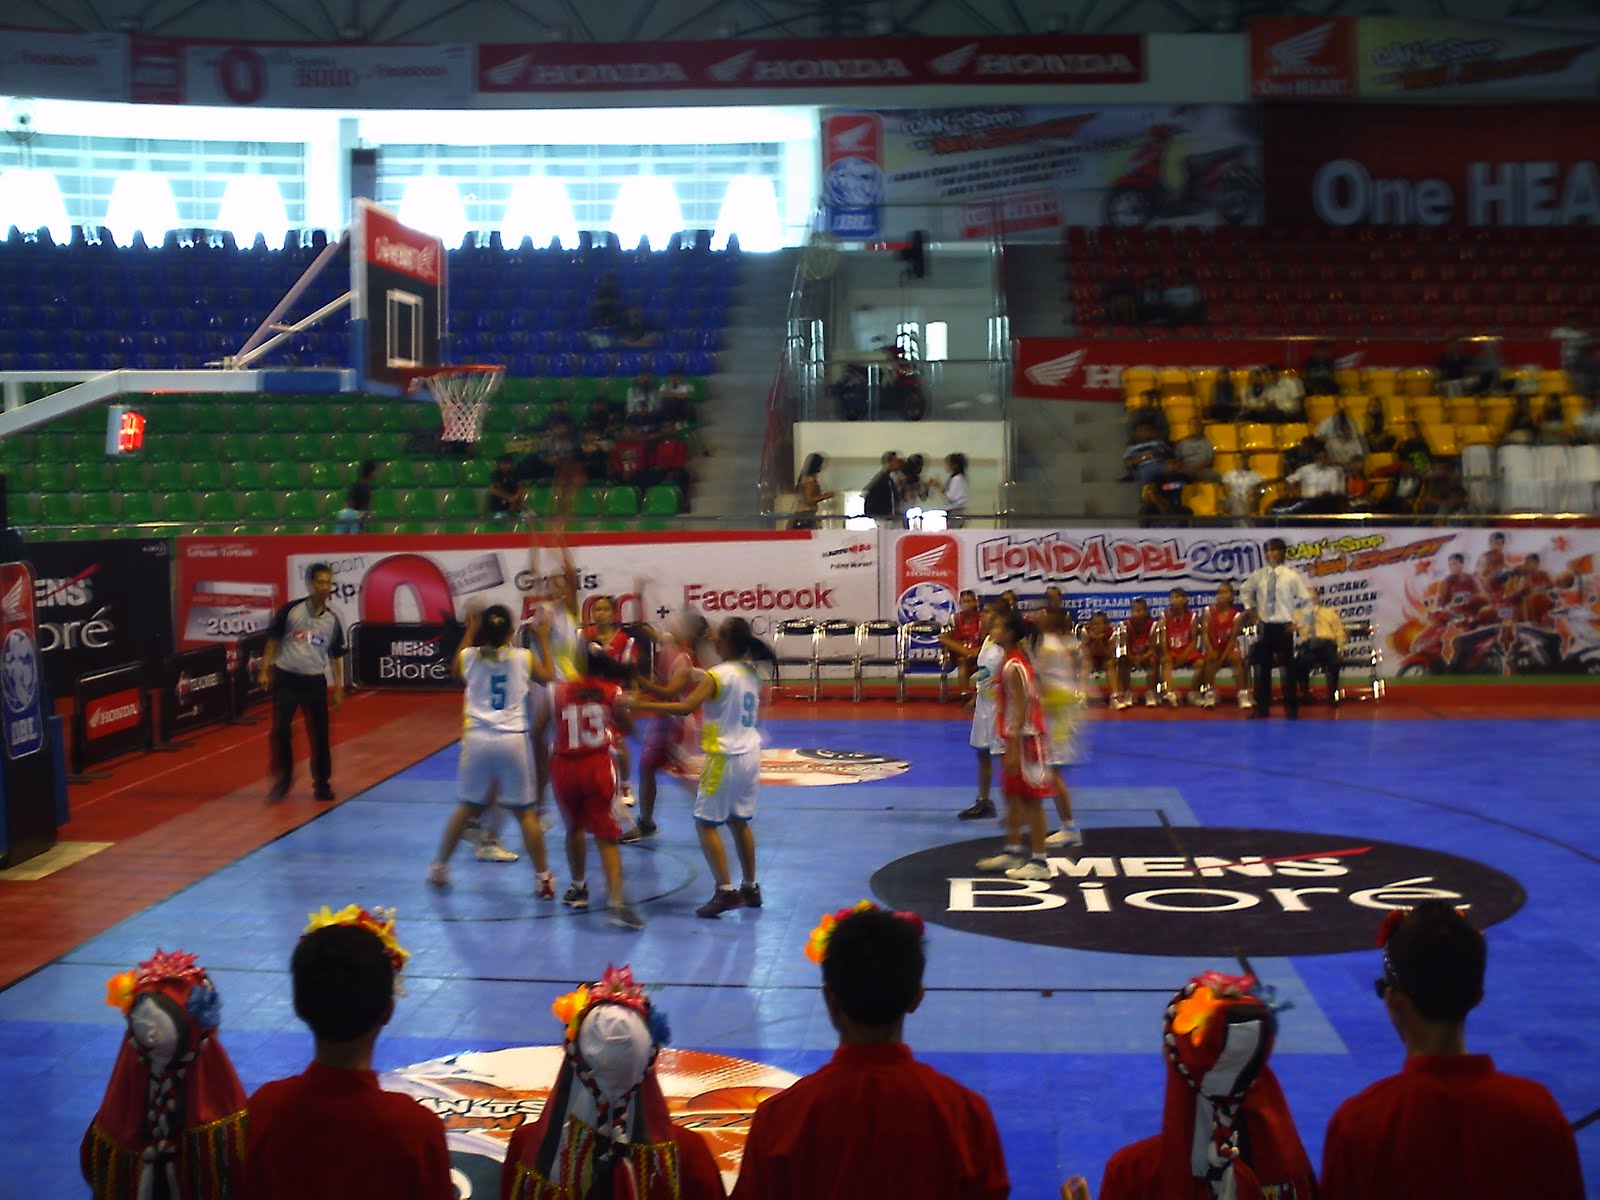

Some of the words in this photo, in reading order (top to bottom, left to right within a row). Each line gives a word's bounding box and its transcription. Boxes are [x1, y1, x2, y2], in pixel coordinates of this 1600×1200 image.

[529, 61, 689, 85] HONDA
[751, 57, 912, 81] HONDA
[974, 53, 1137, 75] HONDA
[1312, 158, 1455, 227] One
[978, 534, 1108, 579] HONDA
[1112, 537, 1188, 576] DBL
[513, 566, 599, 592] Gris
[34, 577, 94, 608] ENS
[683, 583, 838, 613] Facebook
[1324, 592, 1378, 607] GGALKAN
[38, 605, 115, 652] oré
[205, 619, 257, 636] 2000
[391, 641, 434, 657] MENS
[380, 658, 447, 680] Bioré
[490, 674, 507, 710] 5
[101, 703, 138, 725] HONDA
[742, 690, 758, 727] 9
[561, 702, 606, 749] 13
[1046, 856, 1350, 878] MENS
[946, 876, 1472, 913] Bioré
